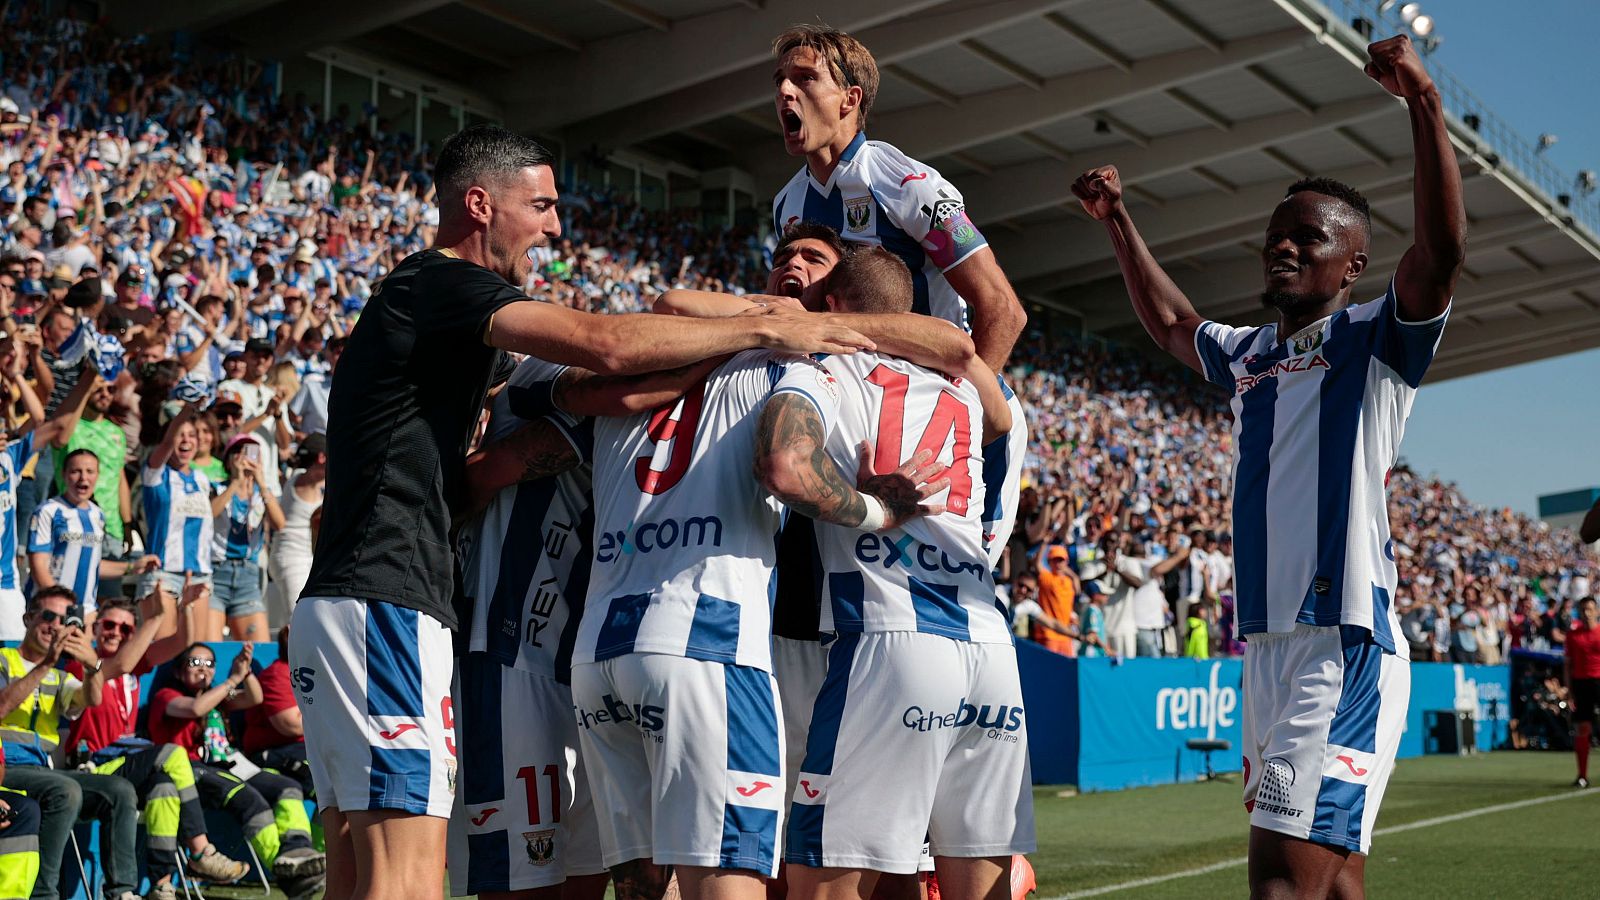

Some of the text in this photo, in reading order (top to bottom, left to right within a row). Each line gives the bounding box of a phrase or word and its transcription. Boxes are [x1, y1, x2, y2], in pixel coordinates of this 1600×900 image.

[634, 377, 707, 496] 9
[864, 363, 973, 517] 14
[597, 515, 723, 564] excom
[855, 532, 985, 583] excom
[578, 694, 665, 732] hebus
[1156, 661, 1236, 742] renfe
[516, 765, 561, 826] 11
